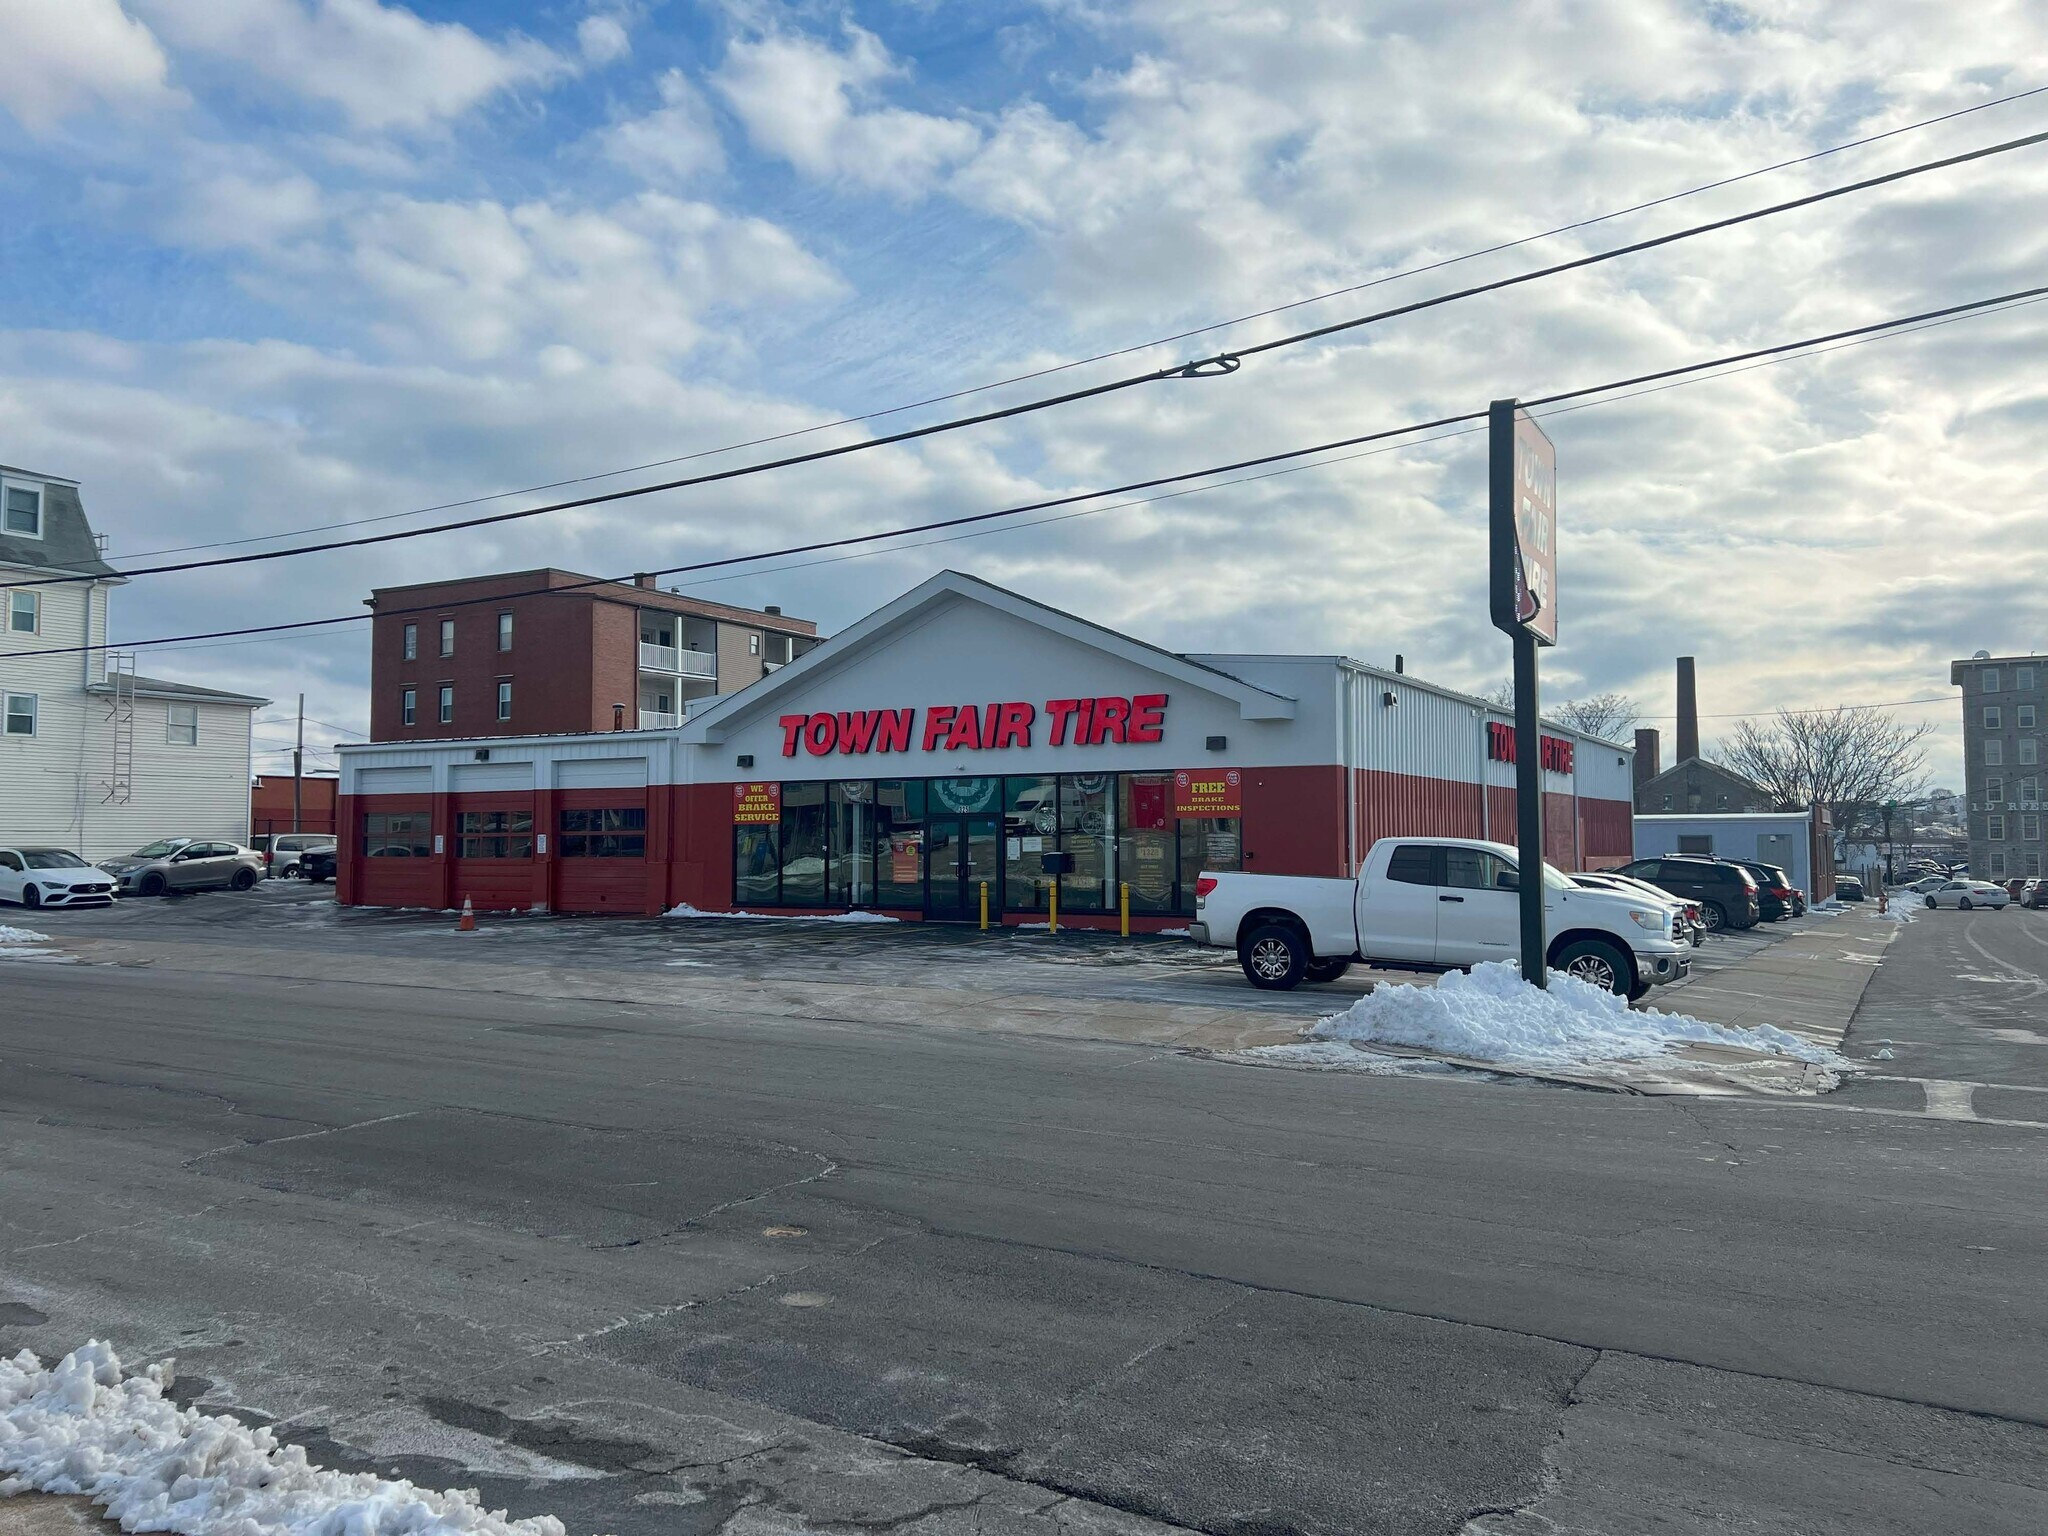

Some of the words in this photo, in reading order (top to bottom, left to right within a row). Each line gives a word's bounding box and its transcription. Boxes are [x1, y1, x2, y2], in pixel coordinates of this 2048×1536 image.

[779, 707, 914, 757] TOWN
[922, 702, 1035, 751] FAIR
[1045, 693, 1169, 746] TIRE
[1487, 721, 1517, 765] TOW
[750, 784, 764, 793] WE
[1191, 782, 1226, 793] FREE
[744, 794, 769, 802] OFFER
[738, 803, 776, 811] BRAKE
[734, 813, 780, 821] SERVICE
